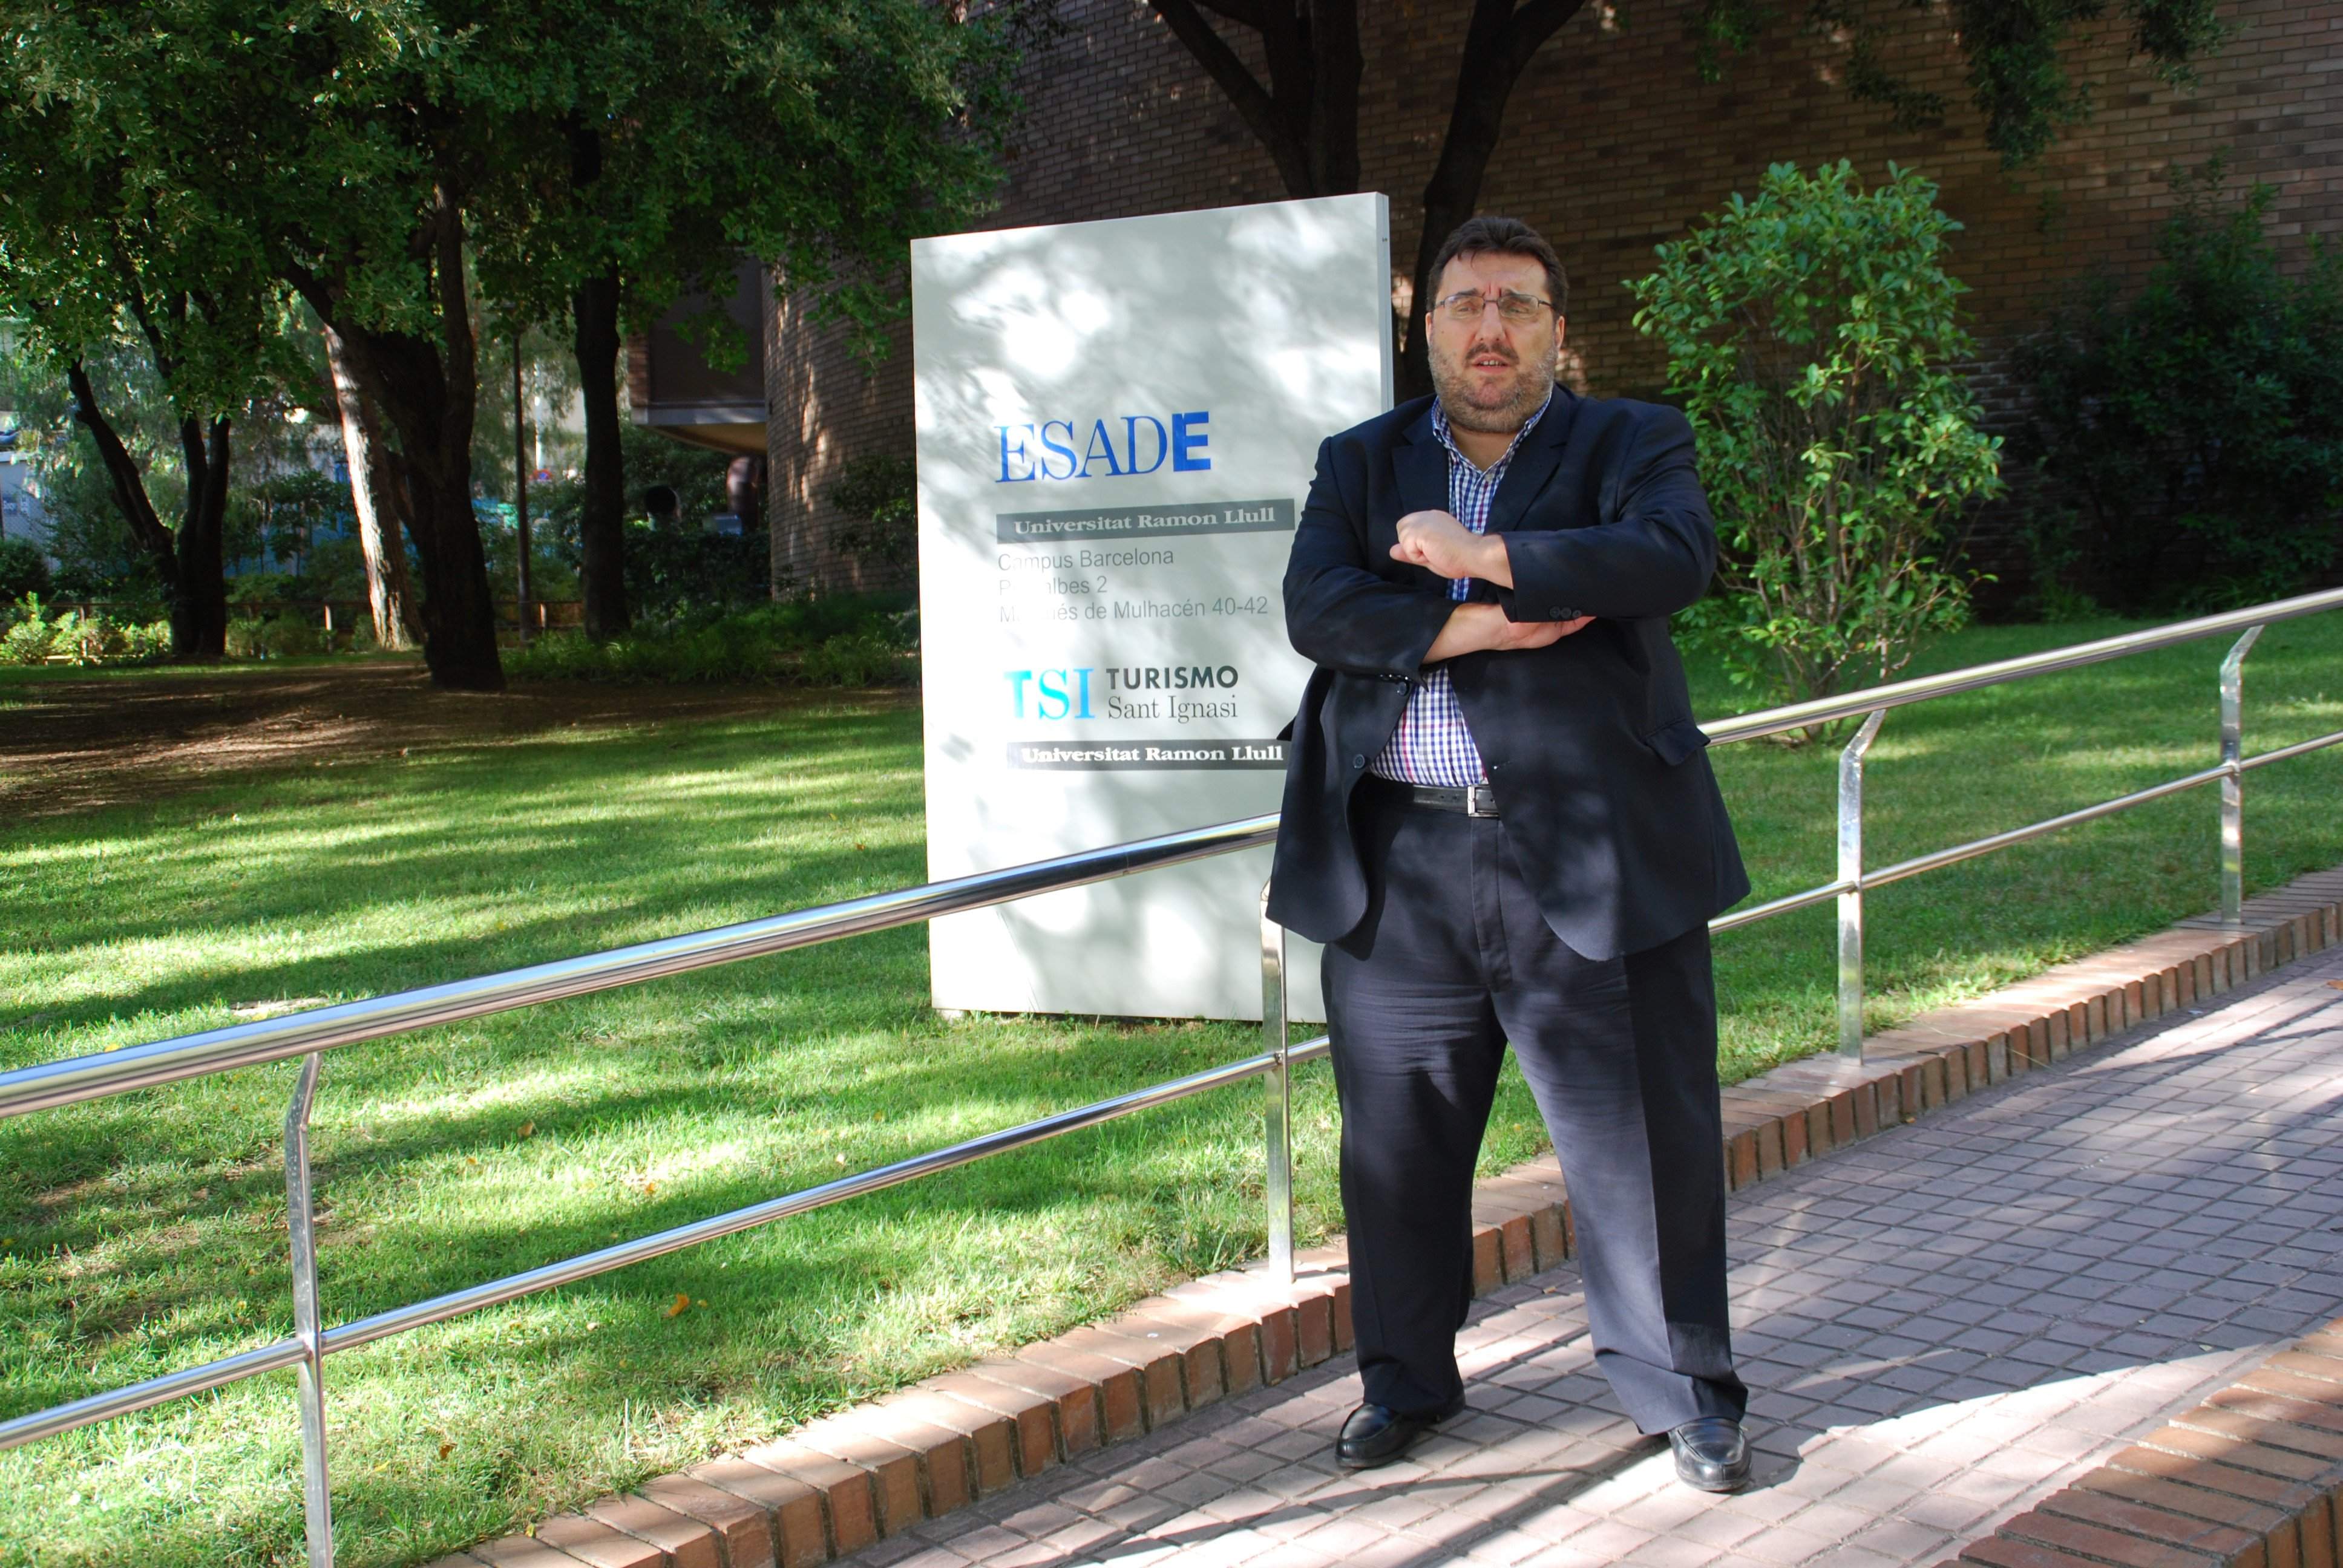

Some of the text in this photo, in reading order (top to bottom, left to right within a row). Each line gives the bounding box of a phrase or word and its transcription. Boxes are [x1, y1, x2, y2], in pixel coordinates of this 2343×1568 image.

[994, 411, 1211, 483] ESADE
[1014, 507, 1276, 535] Universitat Ramon Llull
[998, 548, 1174, 573] Campus Barcelona
[1096, 576, 1107, 593] 2
[1084, 603, 1107, 619] de
[1113, 599, 1205, 619] Mulhacén
[1212, 596, 1268, 615] 40-42
[1106, 665, 1238, 690] TURISMO
[1004, 667, 1096, 720] TSI
[1108, 694, 1239, 724] Sant Ignasi
[1021, 745, 1283, 763] Universitat Ramon Llull
